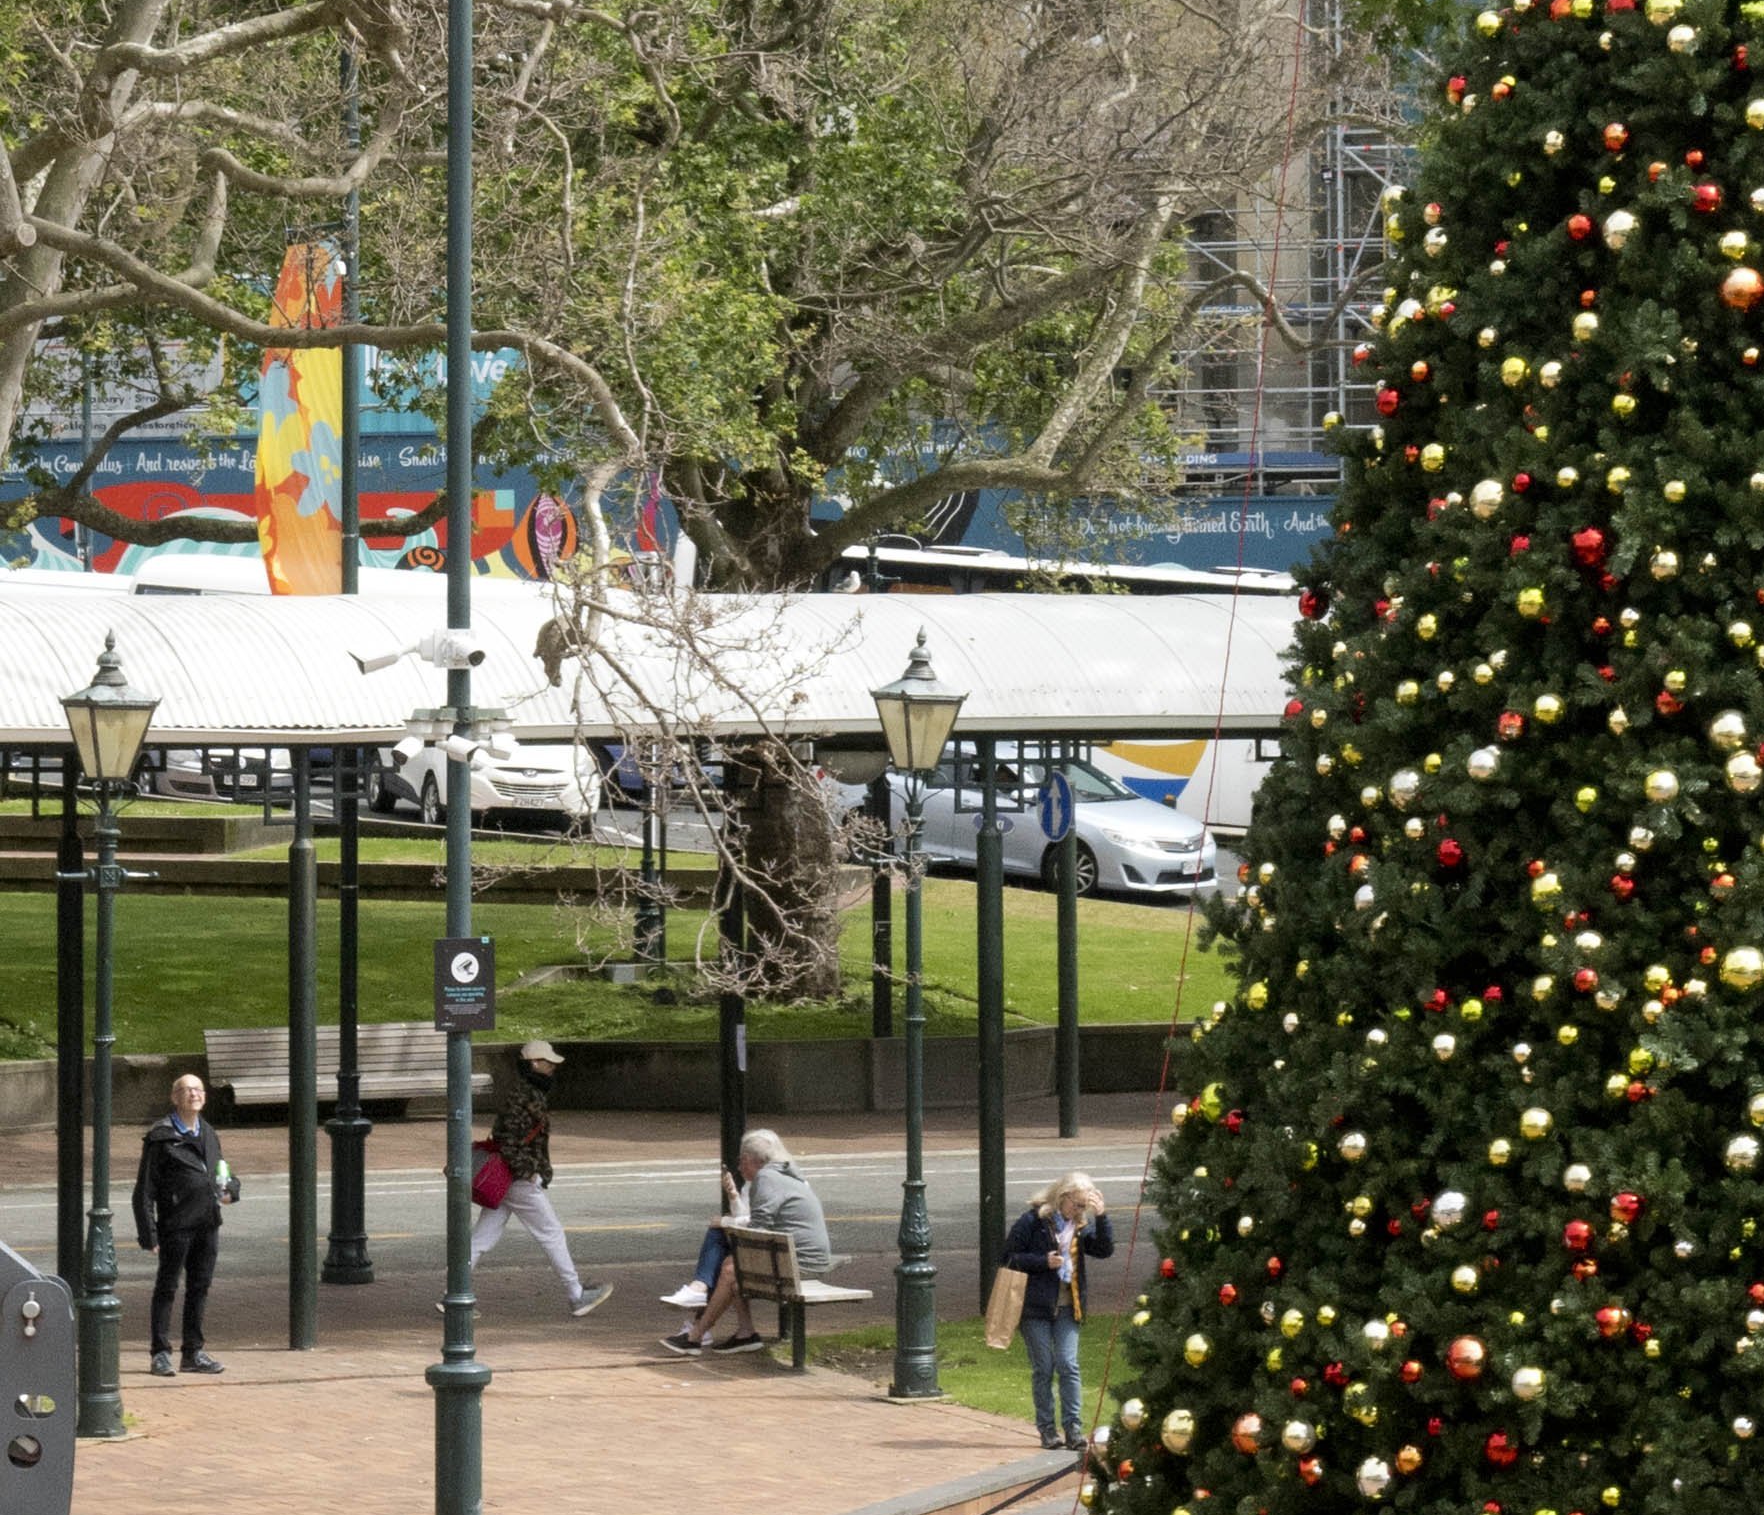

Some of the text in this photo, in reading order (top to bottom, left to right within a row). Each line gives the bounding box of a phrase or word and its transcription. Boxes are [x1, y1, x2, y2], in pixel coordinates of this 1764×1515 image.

[54, 454, 122, 475] Convulus
[135, 452, 162, 473] And
[218, 452, 236, 468] the
[1283, 510, 1317, 535] And
